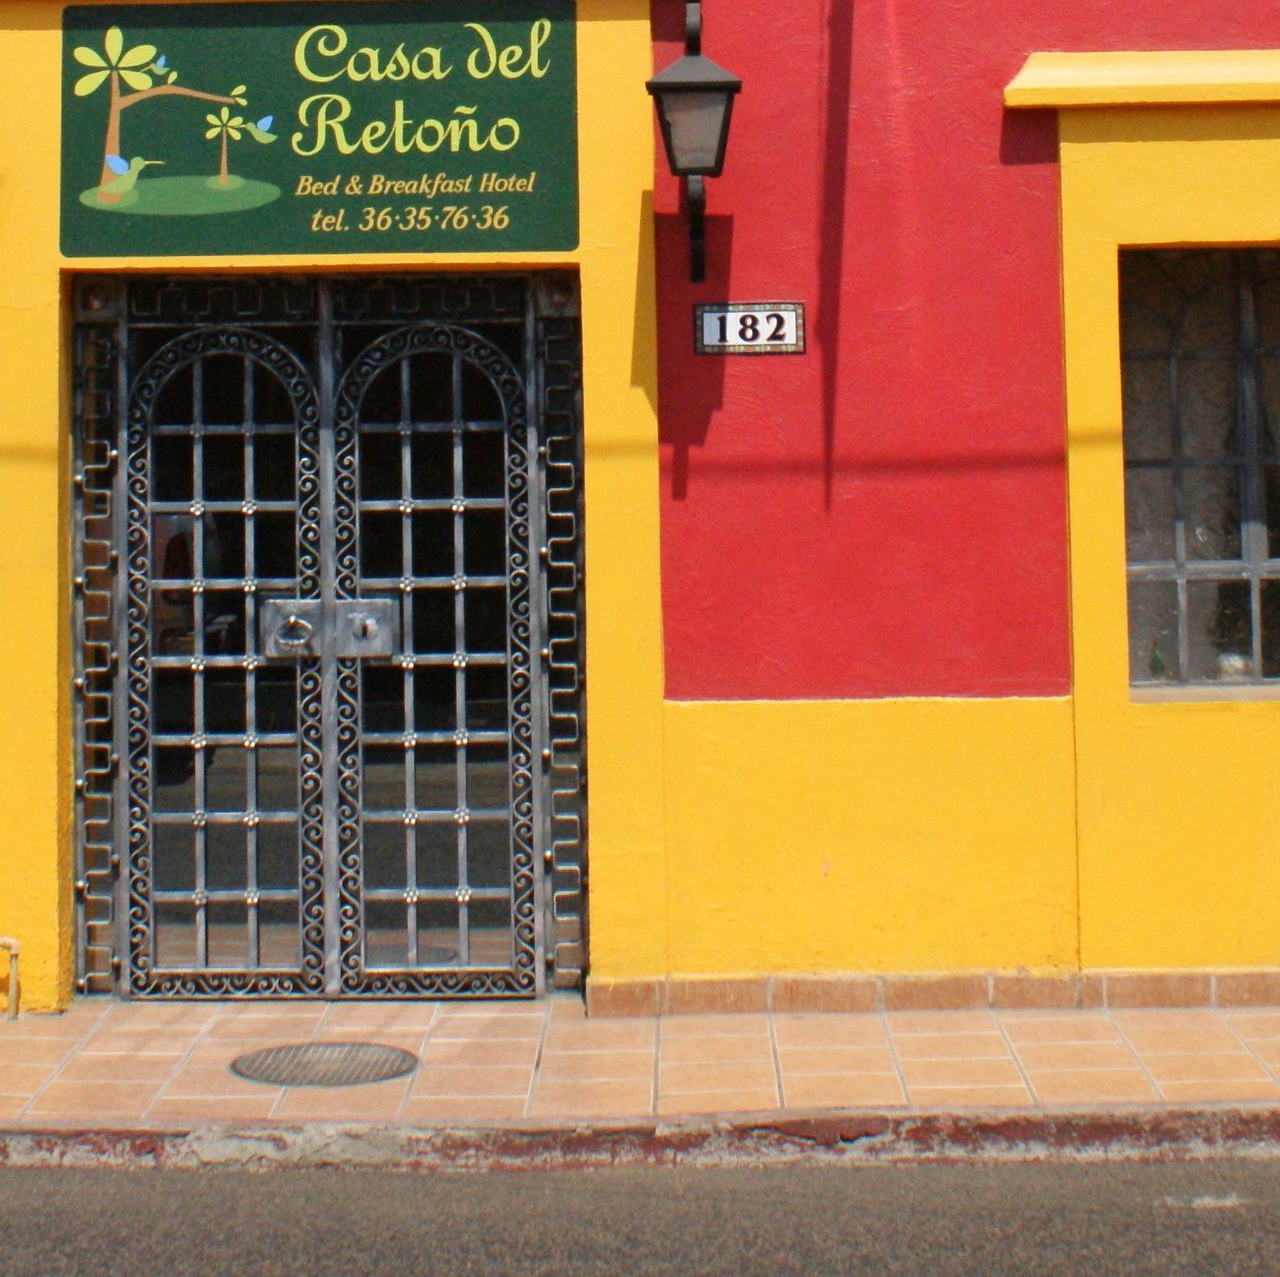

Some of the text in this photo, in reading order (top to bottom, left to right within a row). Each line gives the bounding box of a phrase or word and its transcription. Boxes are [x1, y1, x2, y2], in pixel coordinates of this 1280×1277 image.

[294, 18, 552, 83] Casa del
[291, 93, 520, 156] Retoño
[295, 172, 536, 199] Bed & Breakfast Hotel
[311, 209, 350, 232] tel.
[717, 313, 786, 343] 182
